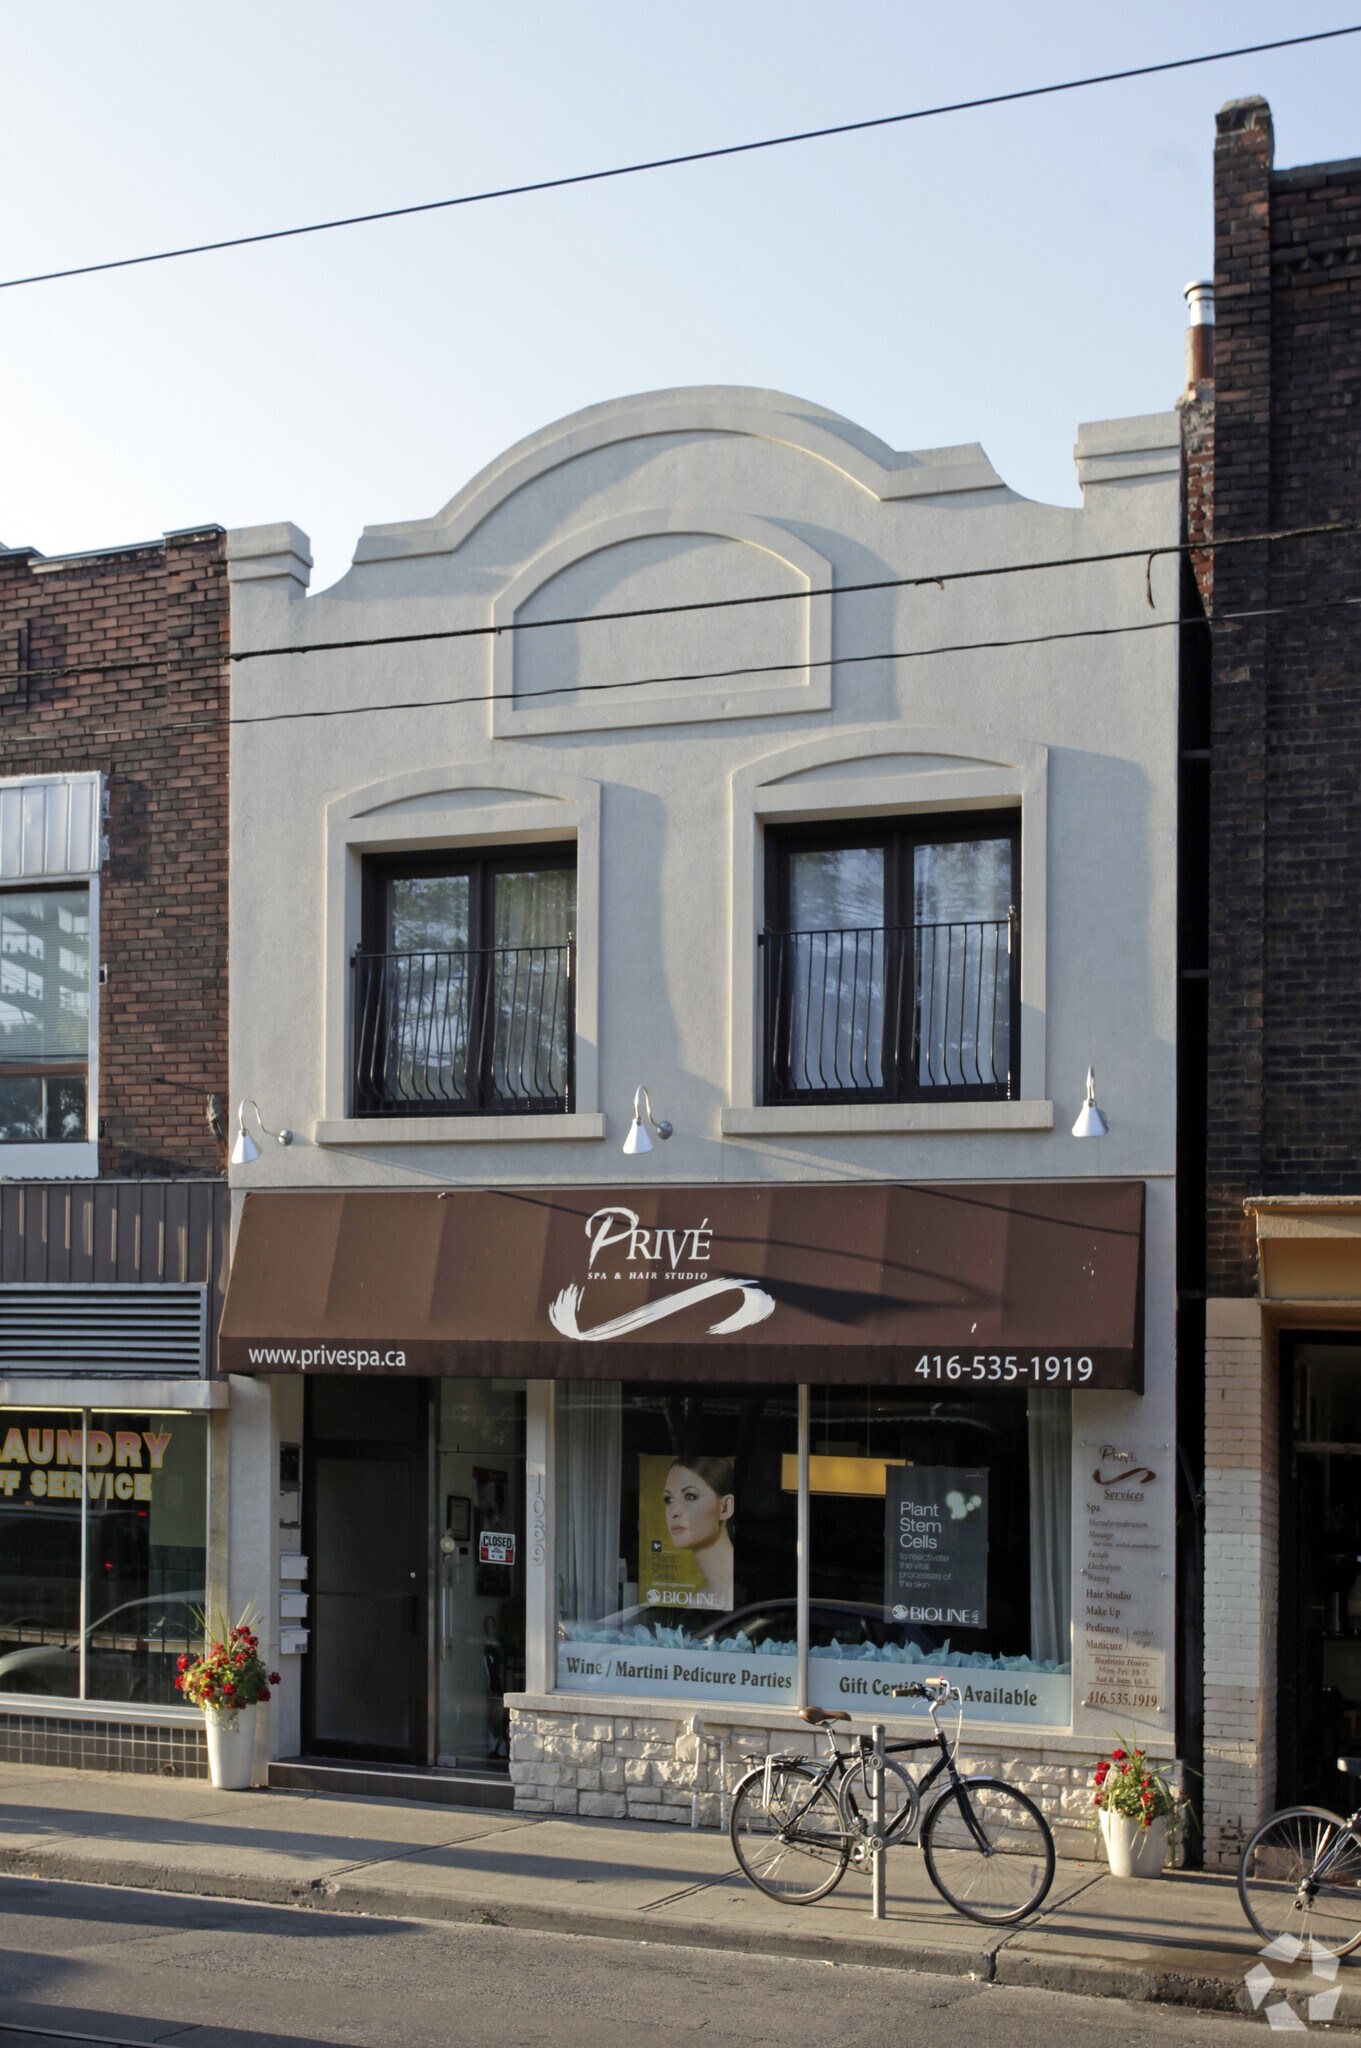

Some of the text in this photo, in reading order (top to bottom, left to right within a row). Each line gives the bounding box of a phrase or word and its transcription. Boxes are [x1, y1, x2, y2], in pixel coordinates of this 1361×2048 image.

[585, 1207, 713, 1270] PRIVÉ
[587, 1271, 708, 1280] SPA & HAIR STUDIO
[248, 1344, 406, 1371] www.privespa.ca
[914, 1354, 1093, 1382] 416-535-1919
[0, 1428, 172, 1468] AUNDRY
[30, 1469, 152, 1501] SERVICE
[1104, 1488, 1144, 1500] Services
[900, 1502, 939, 1517] Plant
[1086, 1502, 1101, 1514] Spa
[900, 1518, 942, 1533] Stem
[483, 1535, 512, 1549] CLOSED
[900, 1534, 938, 1549] Cells
[899, 1552, 908, 1561] to
[899, 1561, 913, 1570] the
[899, 1571, 952, 1581] processes of
[899, 1580, 913, 1588] the
[1086, 1589, 1132, 1601] Hair Studio
[910, 1606, 970, 1624] BIOLINE
[1086, 1605, 1121, 1619] Make Up
[1085, 1622, 1120, 1634] Pedicure
[1085, 1639, 1123, 1651] Manicure
[1094, 1656, 1125, 1666] Business
[566, 1657, 792, 1689] Wine / Martini Pedicure Parties
[839, 1676, 868, 1695] Gift
[963, 1684, 1038, 1707] Available
[1087, 1690, 1158, 1707] 416.535.1919
